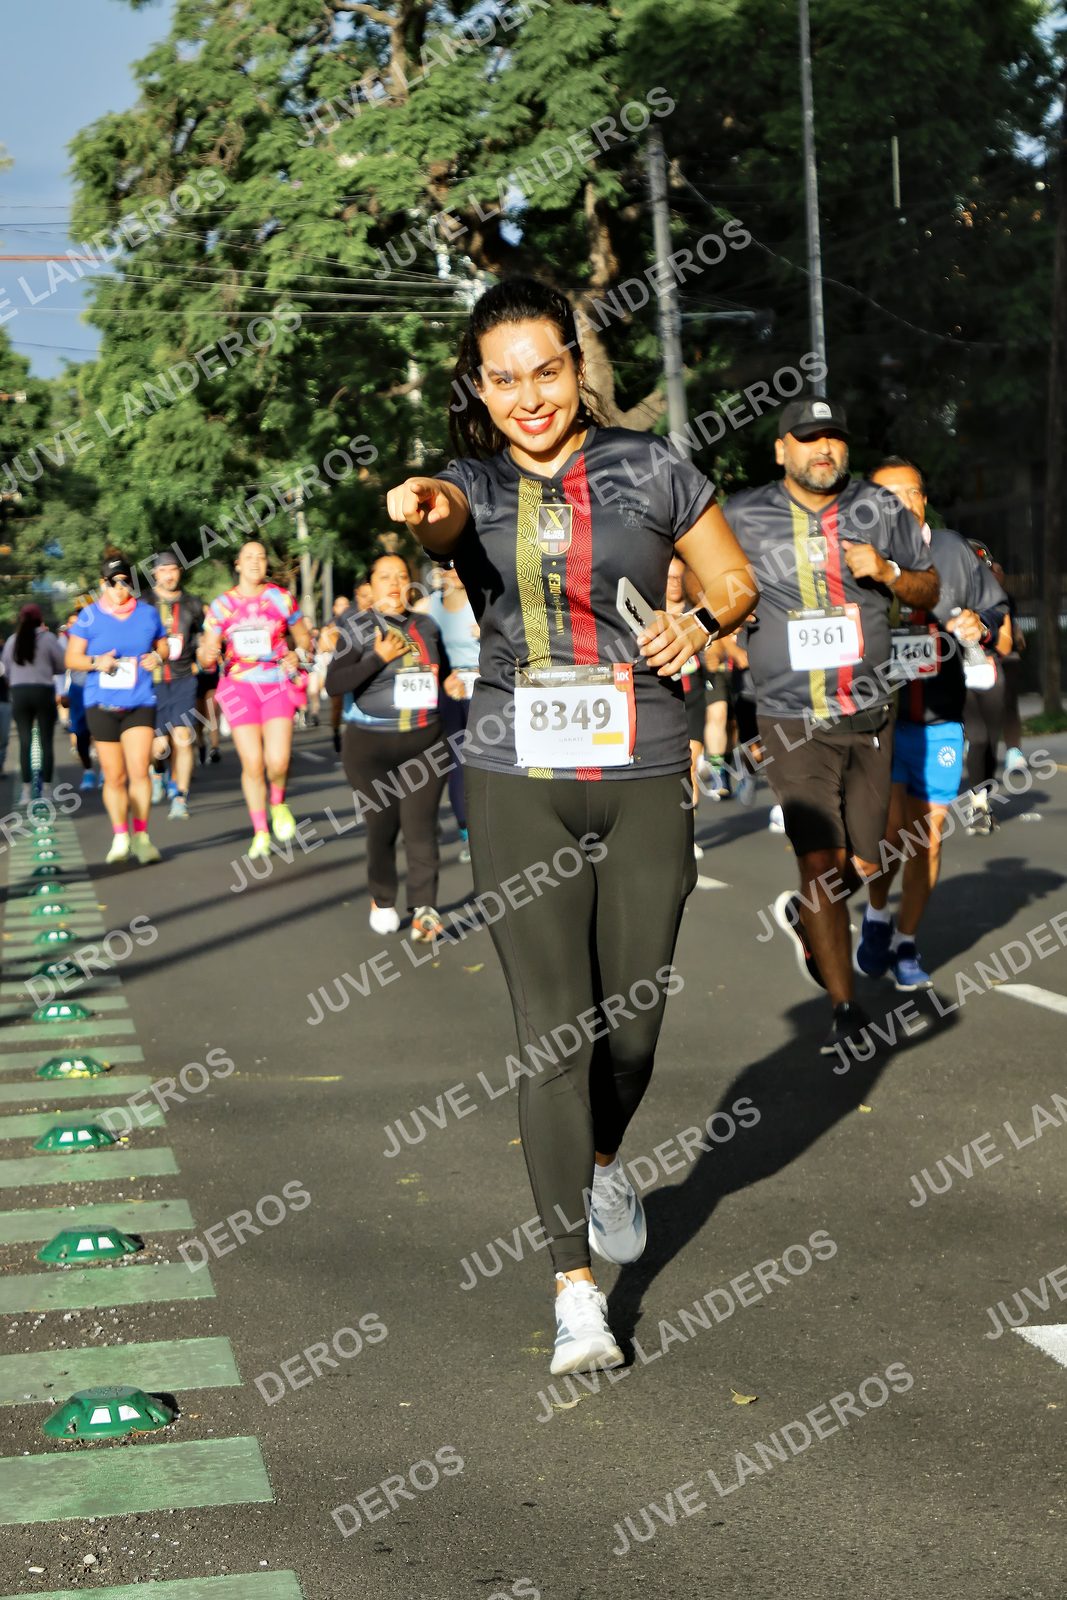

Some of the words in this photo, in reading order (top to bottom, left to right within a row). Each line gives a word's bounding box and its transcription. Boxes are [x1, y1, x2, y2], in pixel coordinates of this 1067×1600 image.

[799, 626, 844, 647] 9361
[401, 678, 431, 692] 9674
[529, 698, 611, 731] 8349
